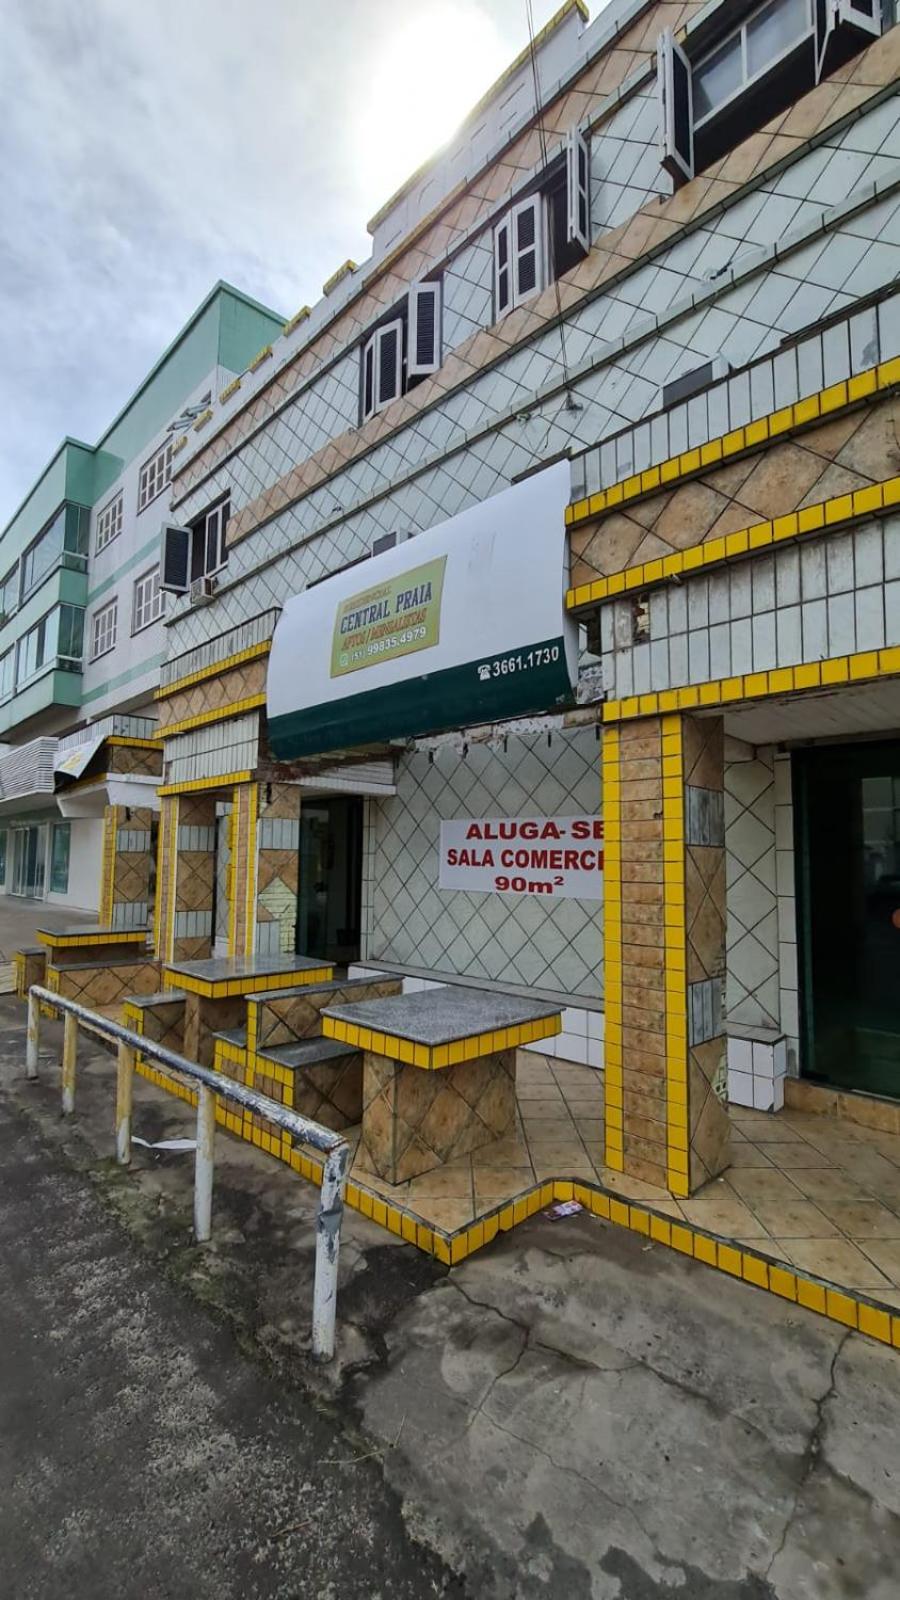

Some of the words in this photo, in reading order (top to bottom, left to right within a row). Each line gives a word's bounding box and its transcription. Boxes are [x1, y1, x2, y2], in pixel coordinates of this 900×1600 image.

[340, 600, 391, 634] CENTRAL
[395, 581, 432, 613] PRAIA
[367, 626, 427, 656] 99835.4979
[492, 646, 559, 677] 3661.1730
[447, 848, 495, 867] SALA
